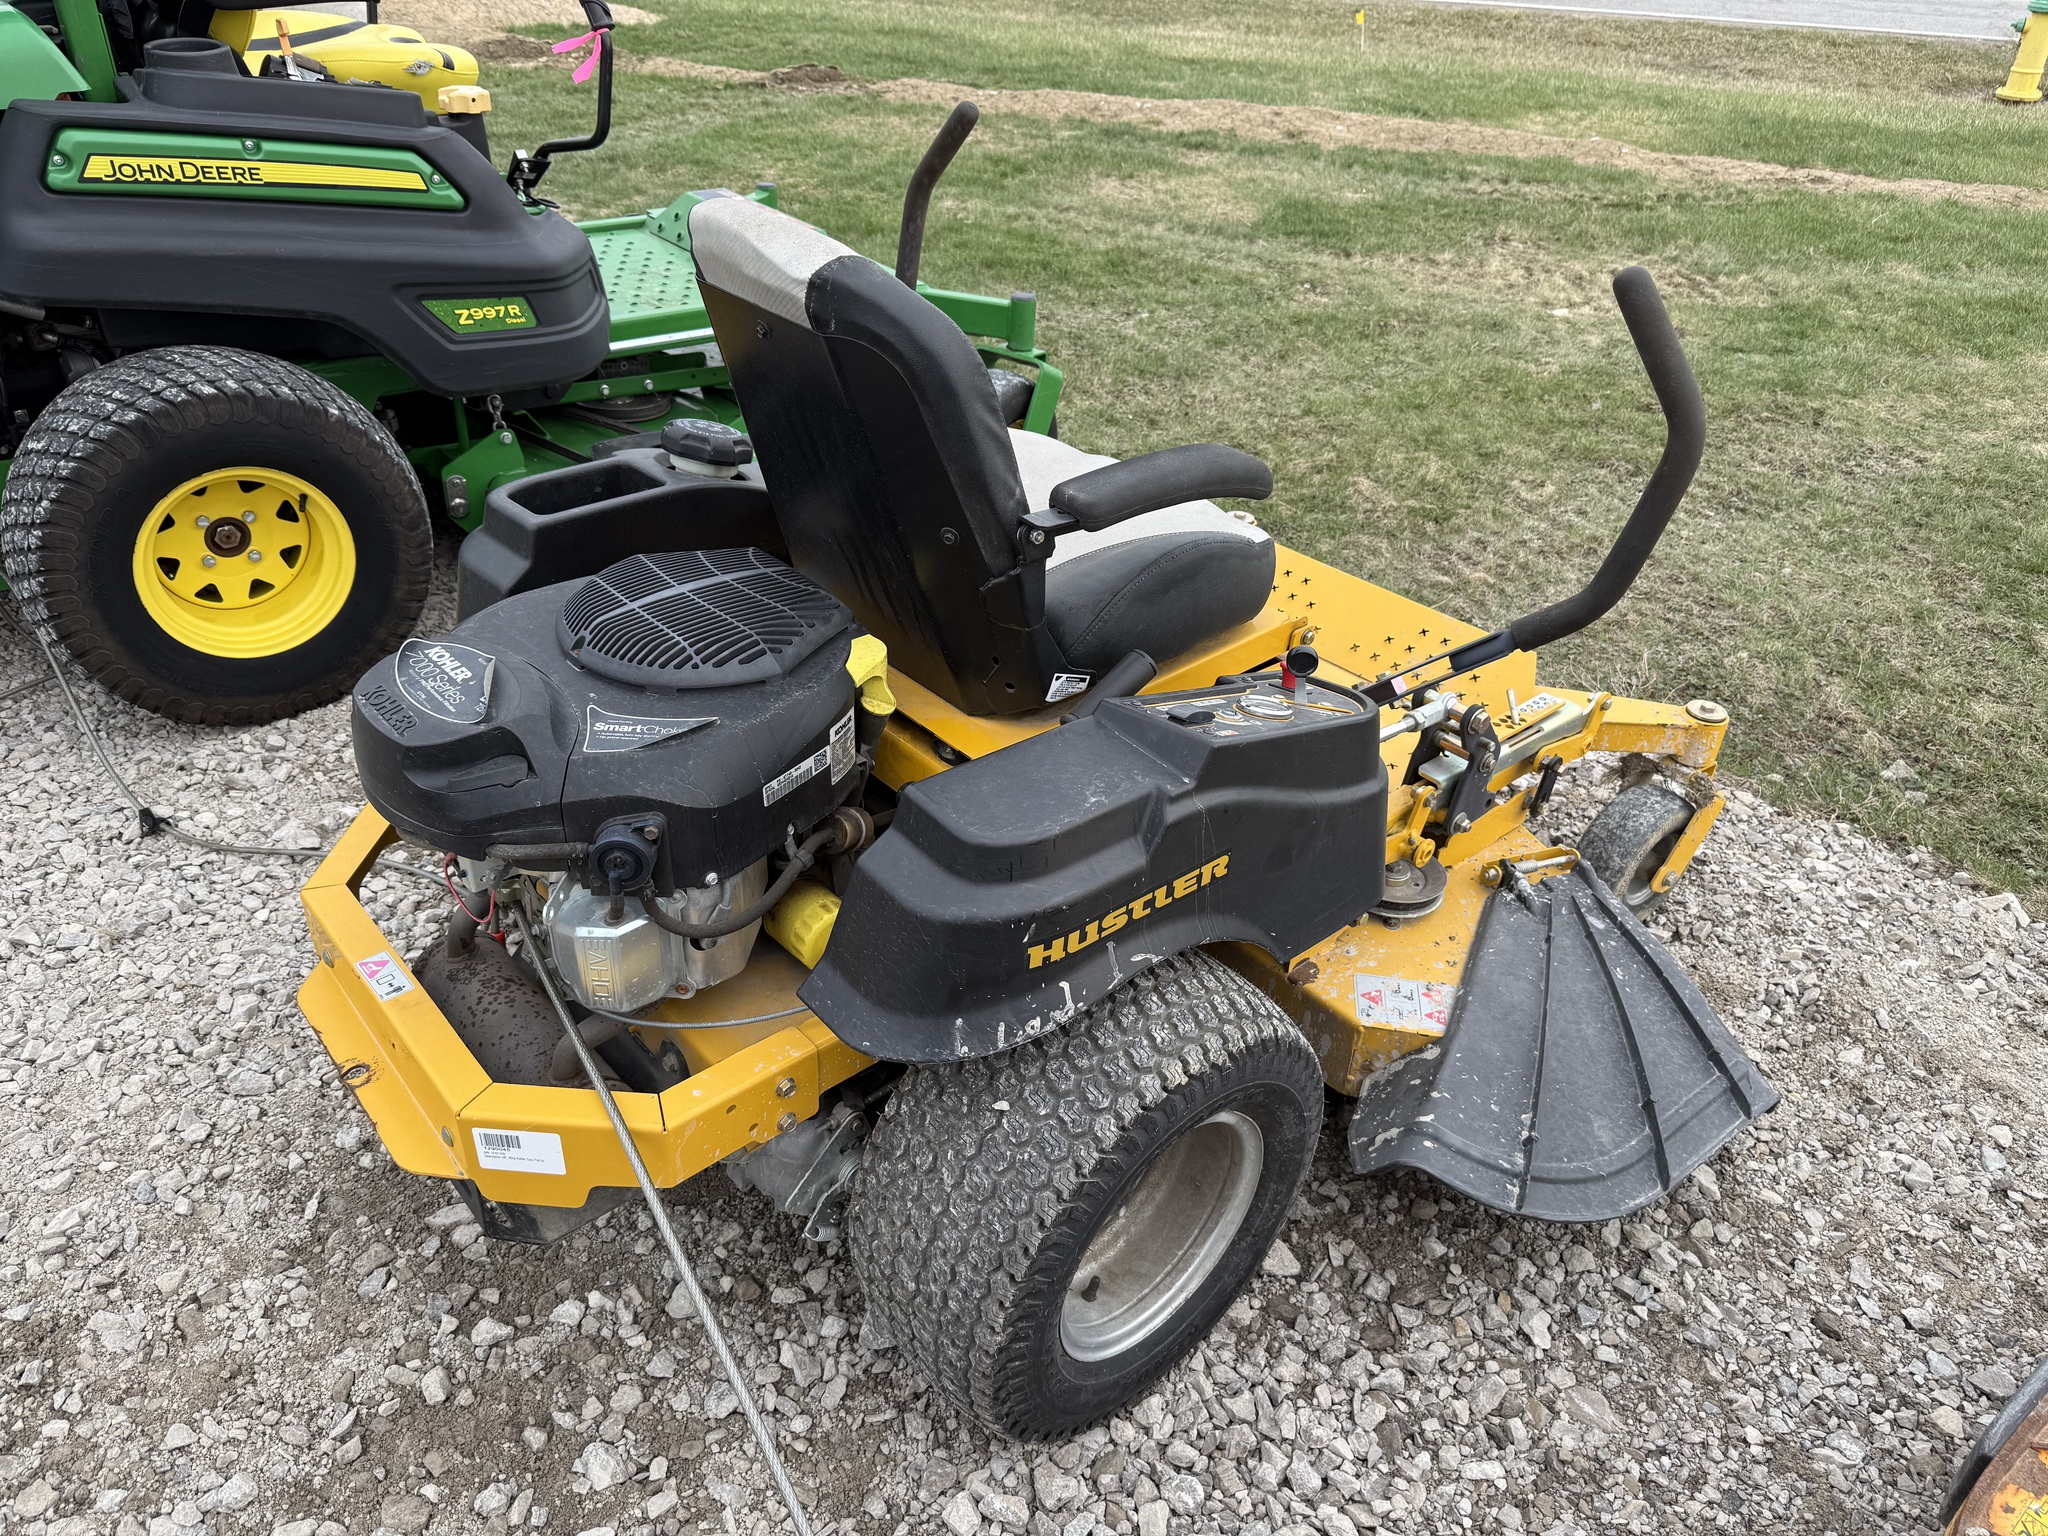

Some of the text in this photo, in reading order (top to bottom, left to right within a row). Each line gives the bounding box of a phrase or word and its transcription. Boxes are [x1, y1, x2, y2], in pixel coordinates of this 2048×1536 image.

[104, 159, 264, 181] JOHN DEERE
[505, 316, 527, 324] Diesel
[405, 650, 439, 678] 7000
[428, 674, 466, 705] Series
[424, 645, 473, 684] KOHLER
[360, 685, 418, 737] KOHLER
[834, 715, 852, 737] KOHLER
[1028, 854, 1230, 969] HUSTLER
